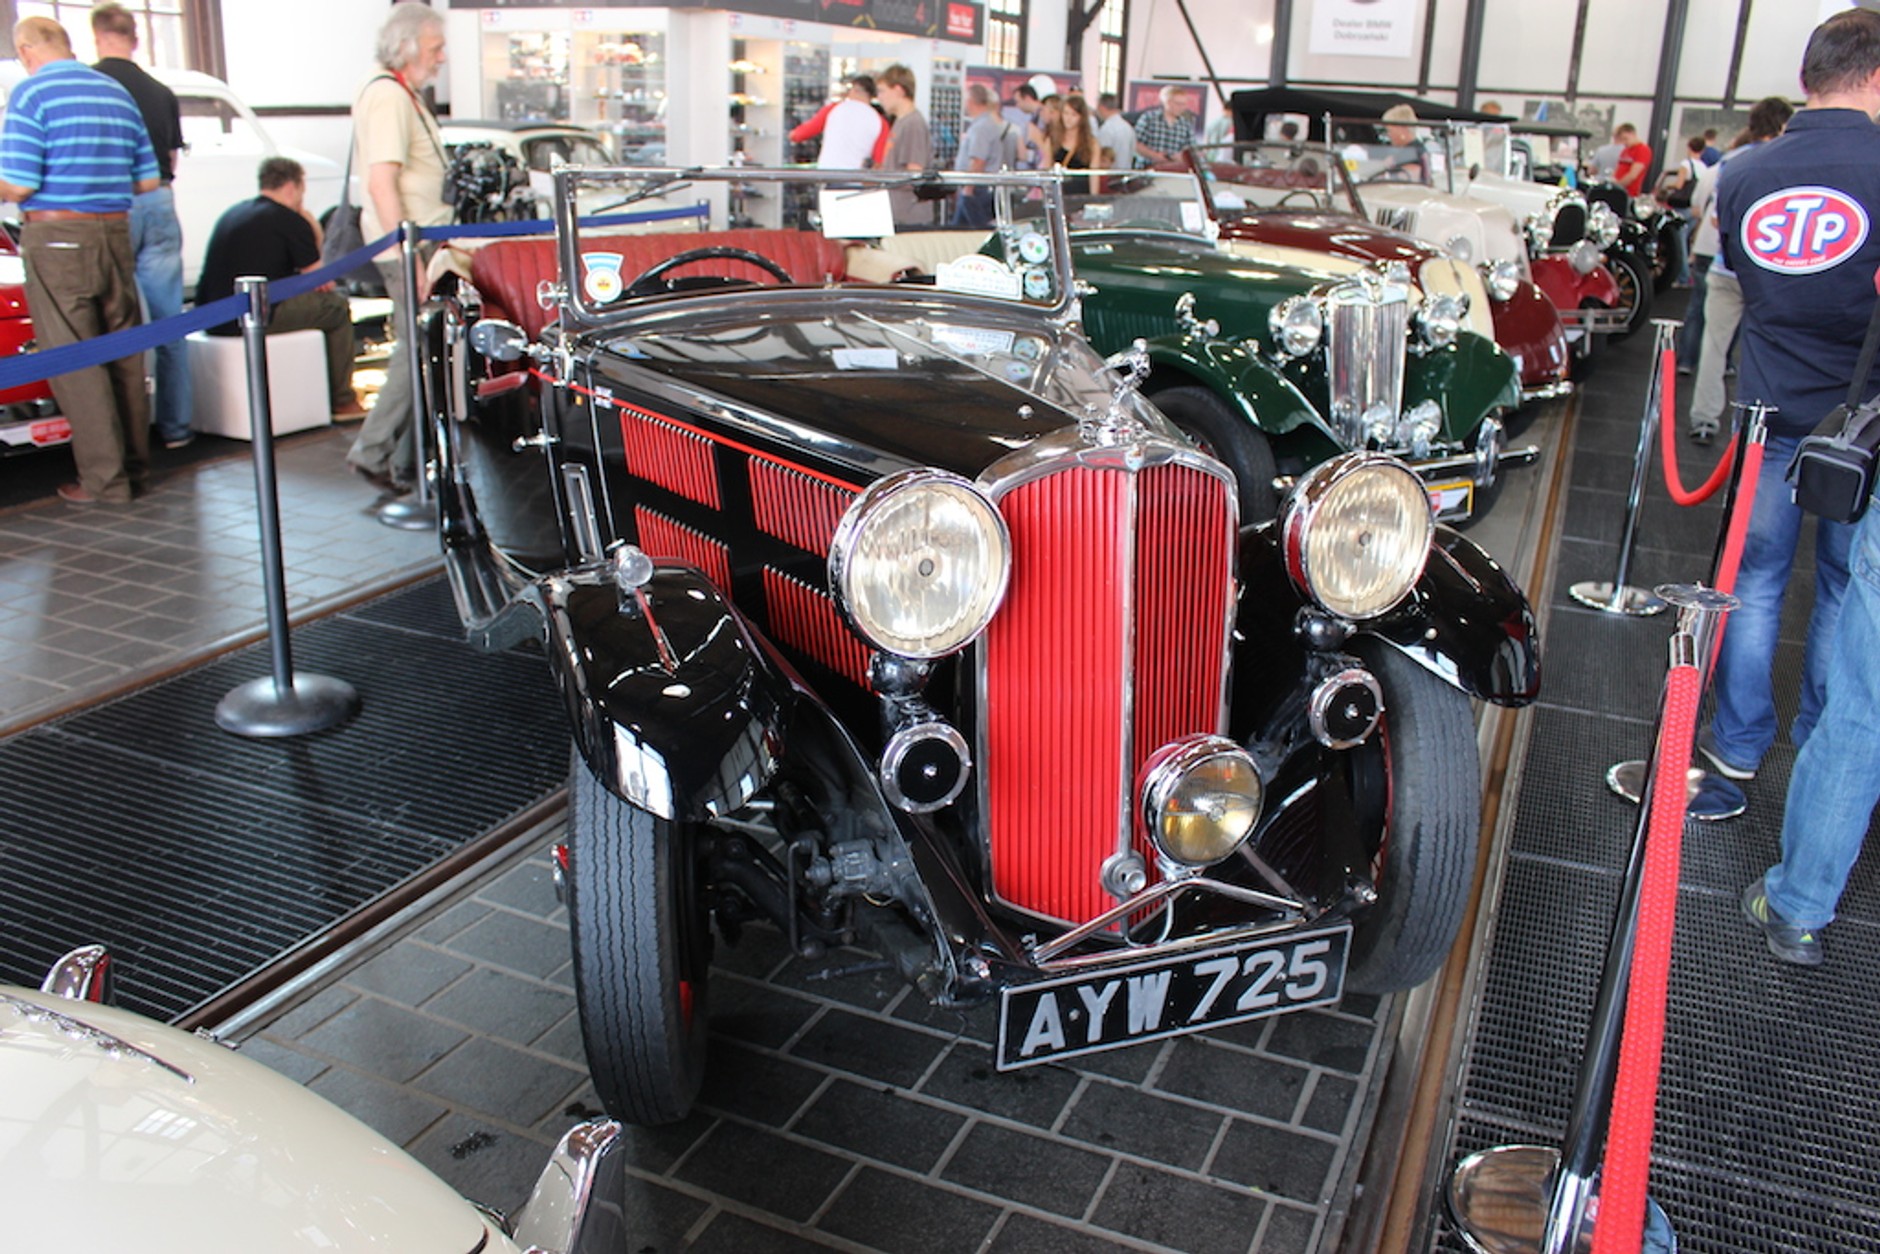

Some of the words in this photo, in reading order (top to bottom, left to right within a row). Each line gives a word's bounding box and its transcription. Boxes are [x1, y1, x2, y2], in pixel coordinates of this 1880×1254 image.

[1366, 19, 1392, 29] BMW
[1754, 198, 1847, 255] STP
[1020, 970, 1173, 1057] AYW
[1188, 940, 1330, 1023] 725
